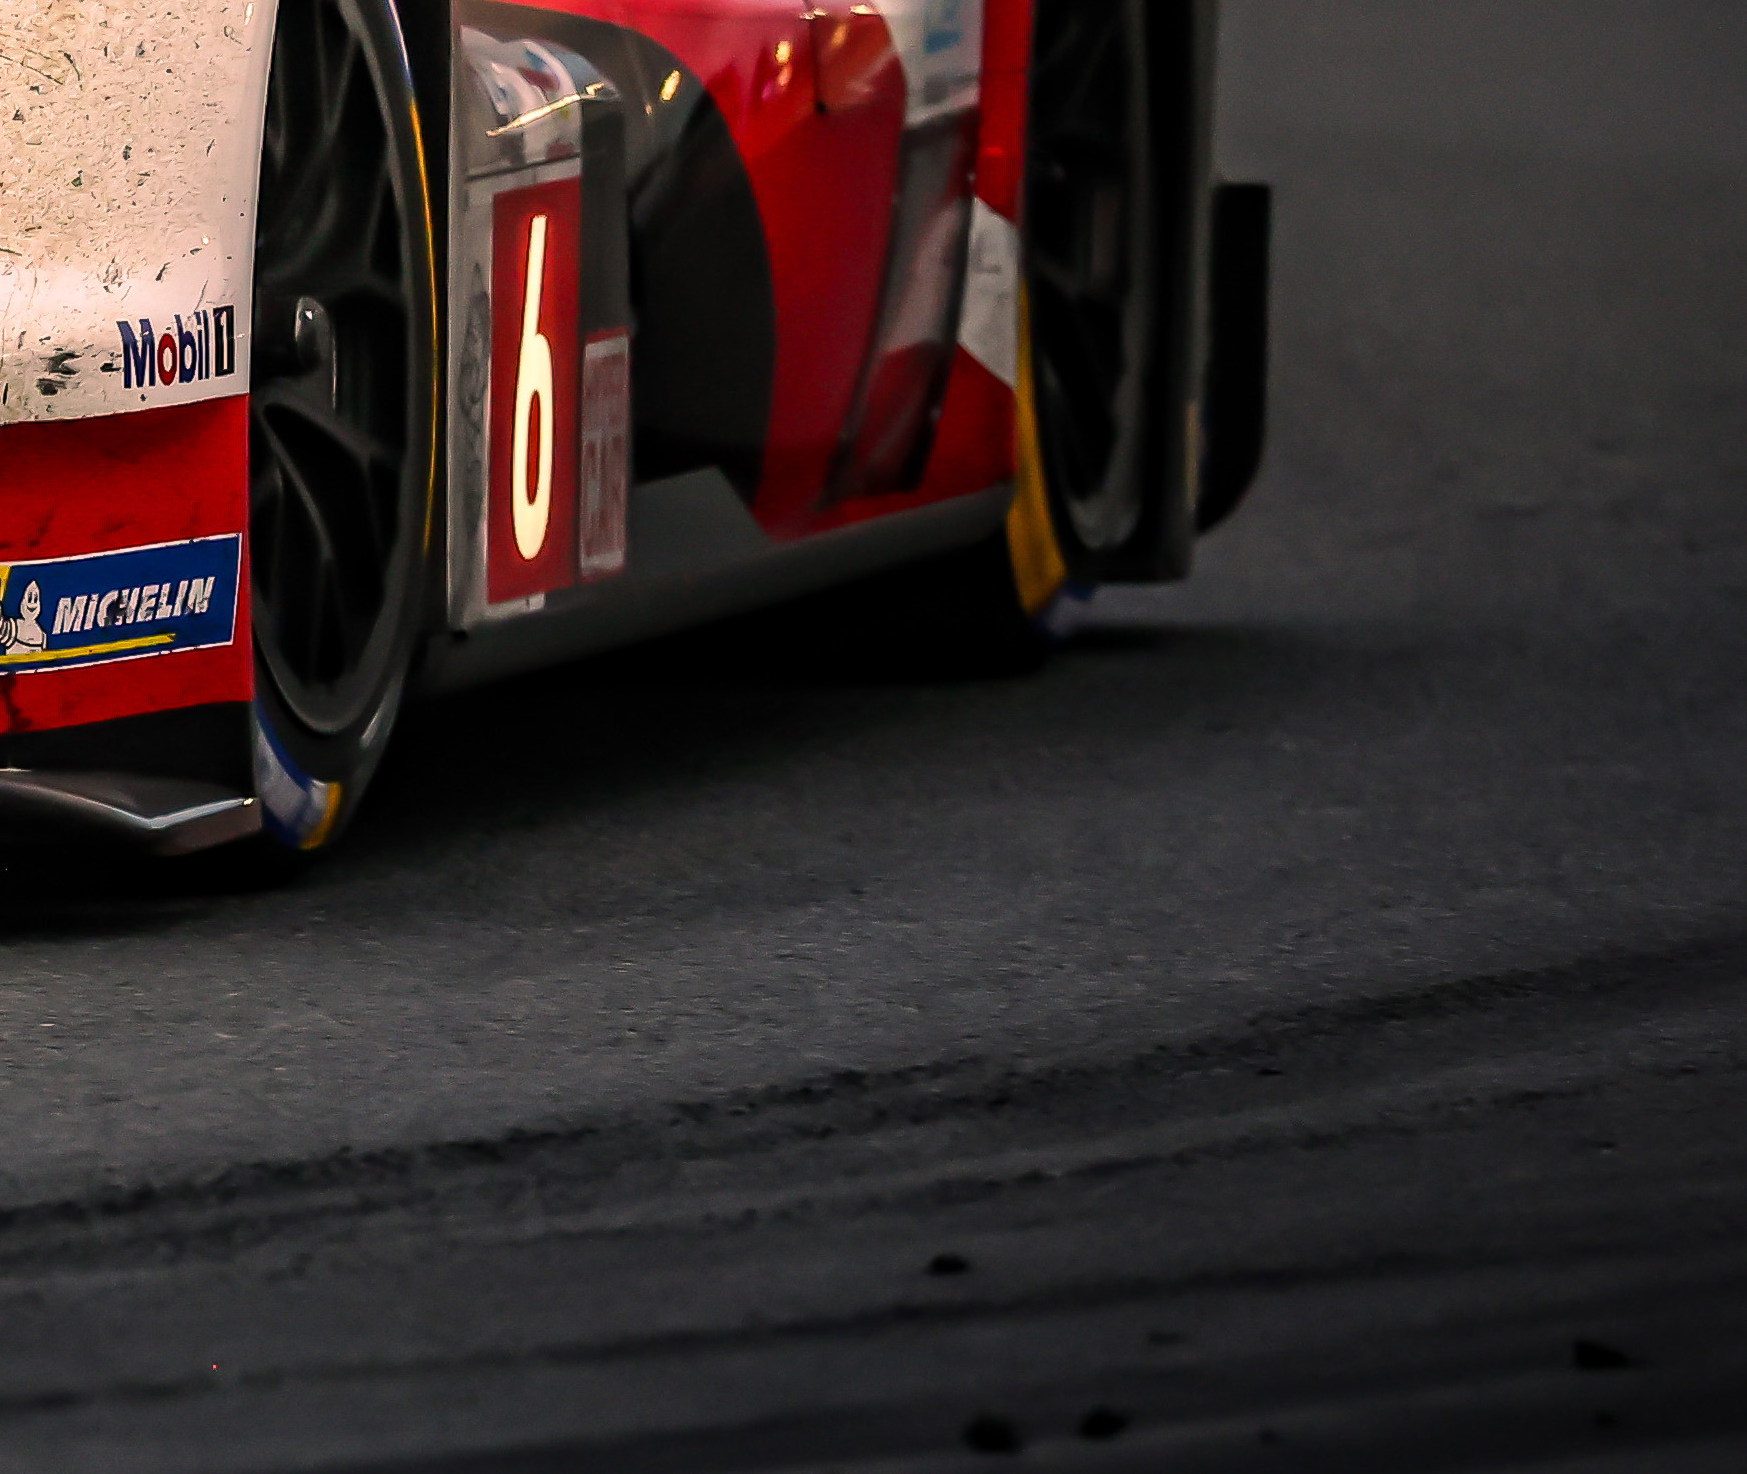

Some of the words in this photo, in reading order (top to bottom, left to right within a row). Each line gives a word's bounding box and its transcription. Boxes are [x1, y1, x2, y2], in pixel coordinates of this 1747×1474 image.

[116, 310, 210, 389] Mobil
[511, 214, 555, 561] 6
[51, 576, 216, 636] MICHELIN
